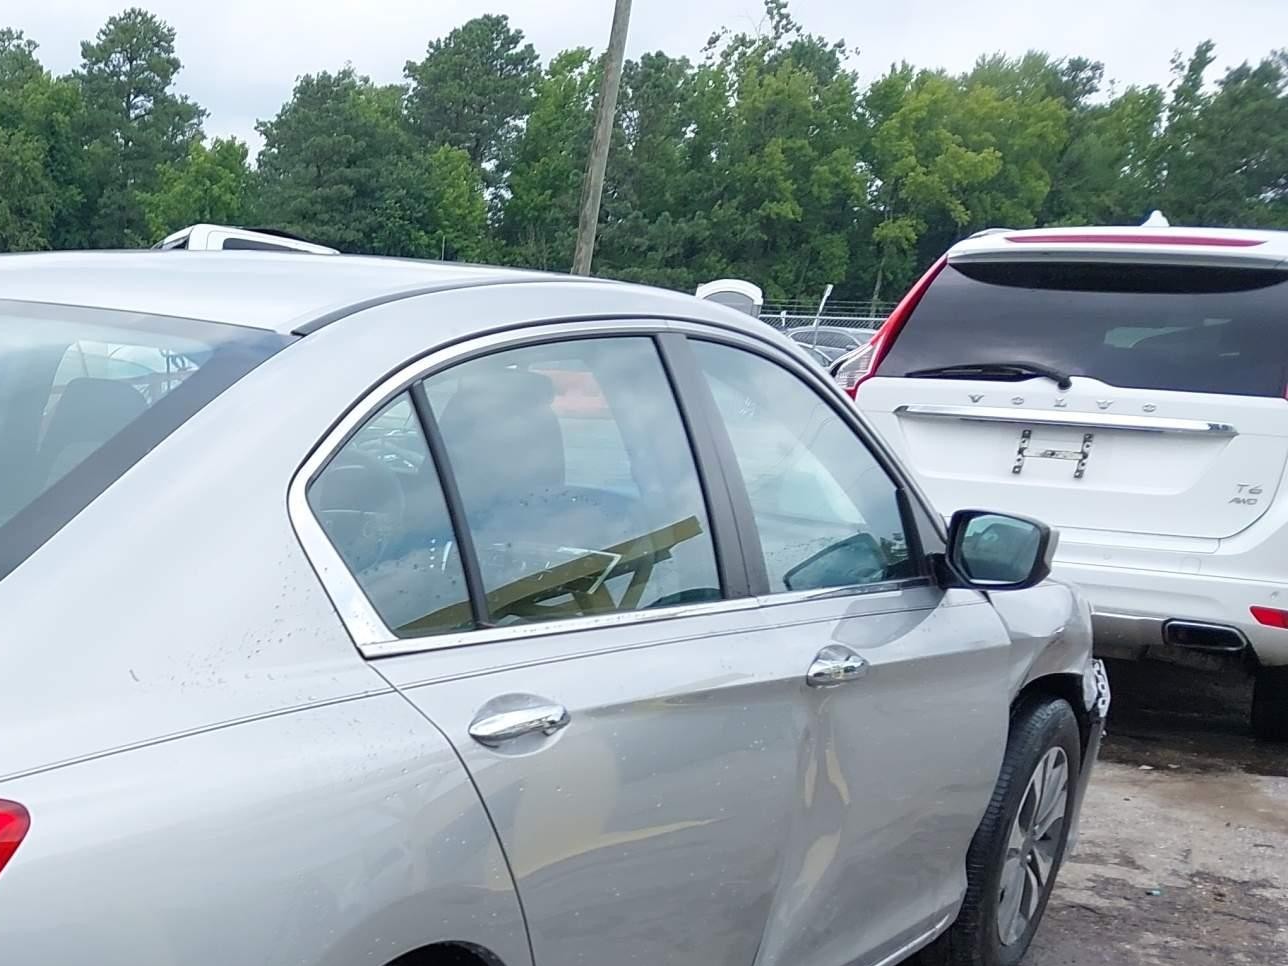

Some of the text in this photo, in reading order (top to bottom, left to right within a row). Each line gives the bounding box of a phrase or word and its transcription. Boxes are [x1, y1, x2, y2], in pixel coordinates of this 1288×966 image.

[968, 394, 1157, 413] VOLVO
[1236, 482, 1263, 495] T6
[1227, 496, 1259, 505] AWD
